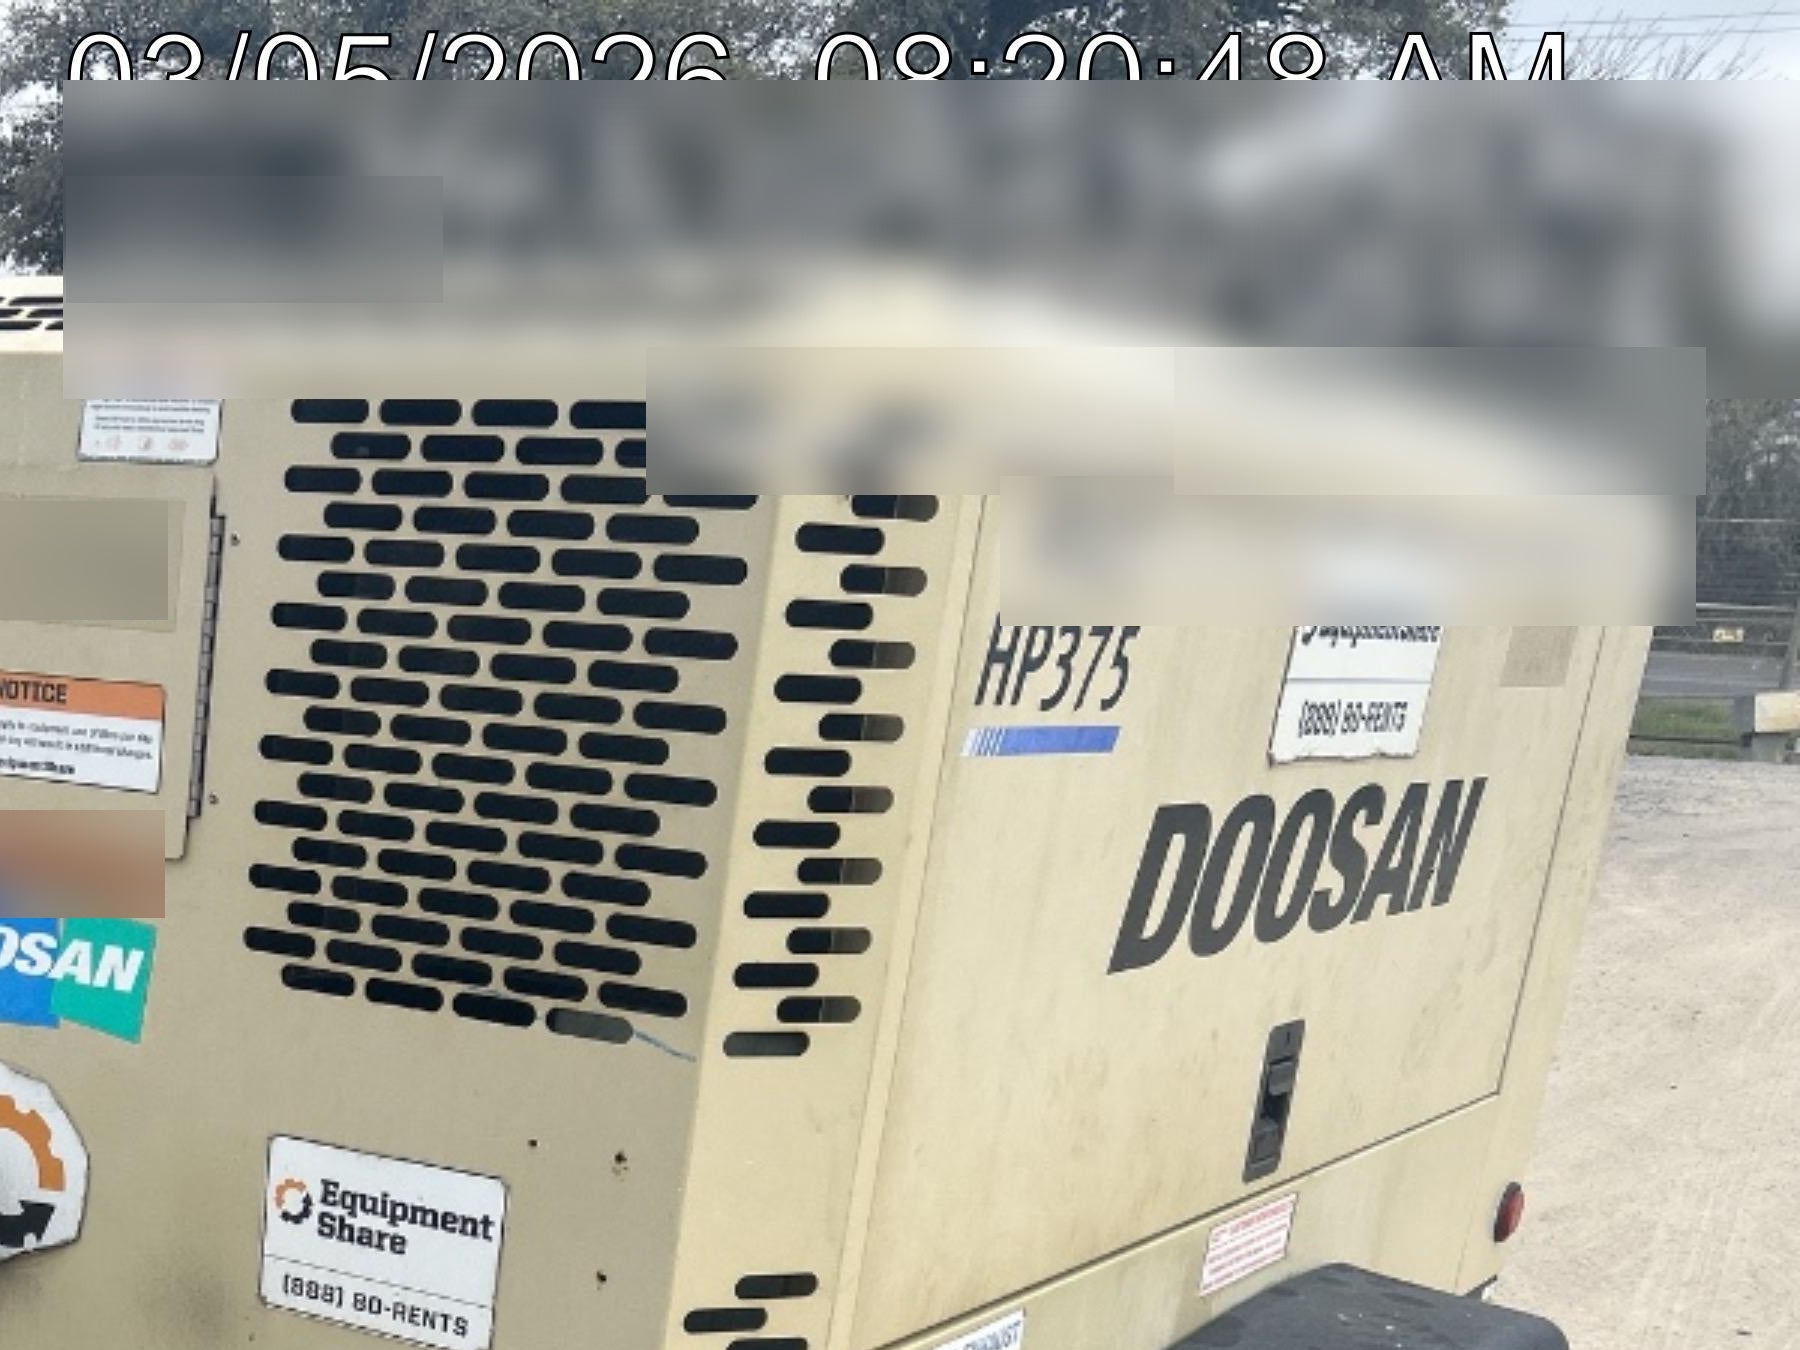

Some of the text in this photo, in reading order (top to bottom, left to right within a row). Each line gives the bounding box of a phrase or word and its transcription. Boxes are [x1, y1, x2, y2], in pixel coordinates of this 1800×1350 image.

[973, 612, 1141, 712] HP375
[1106, 775, 1489, 976] DOOSAN
[317, 1212, 408, 1255] Share
[319, 1178, 496, 1241] Equipment
